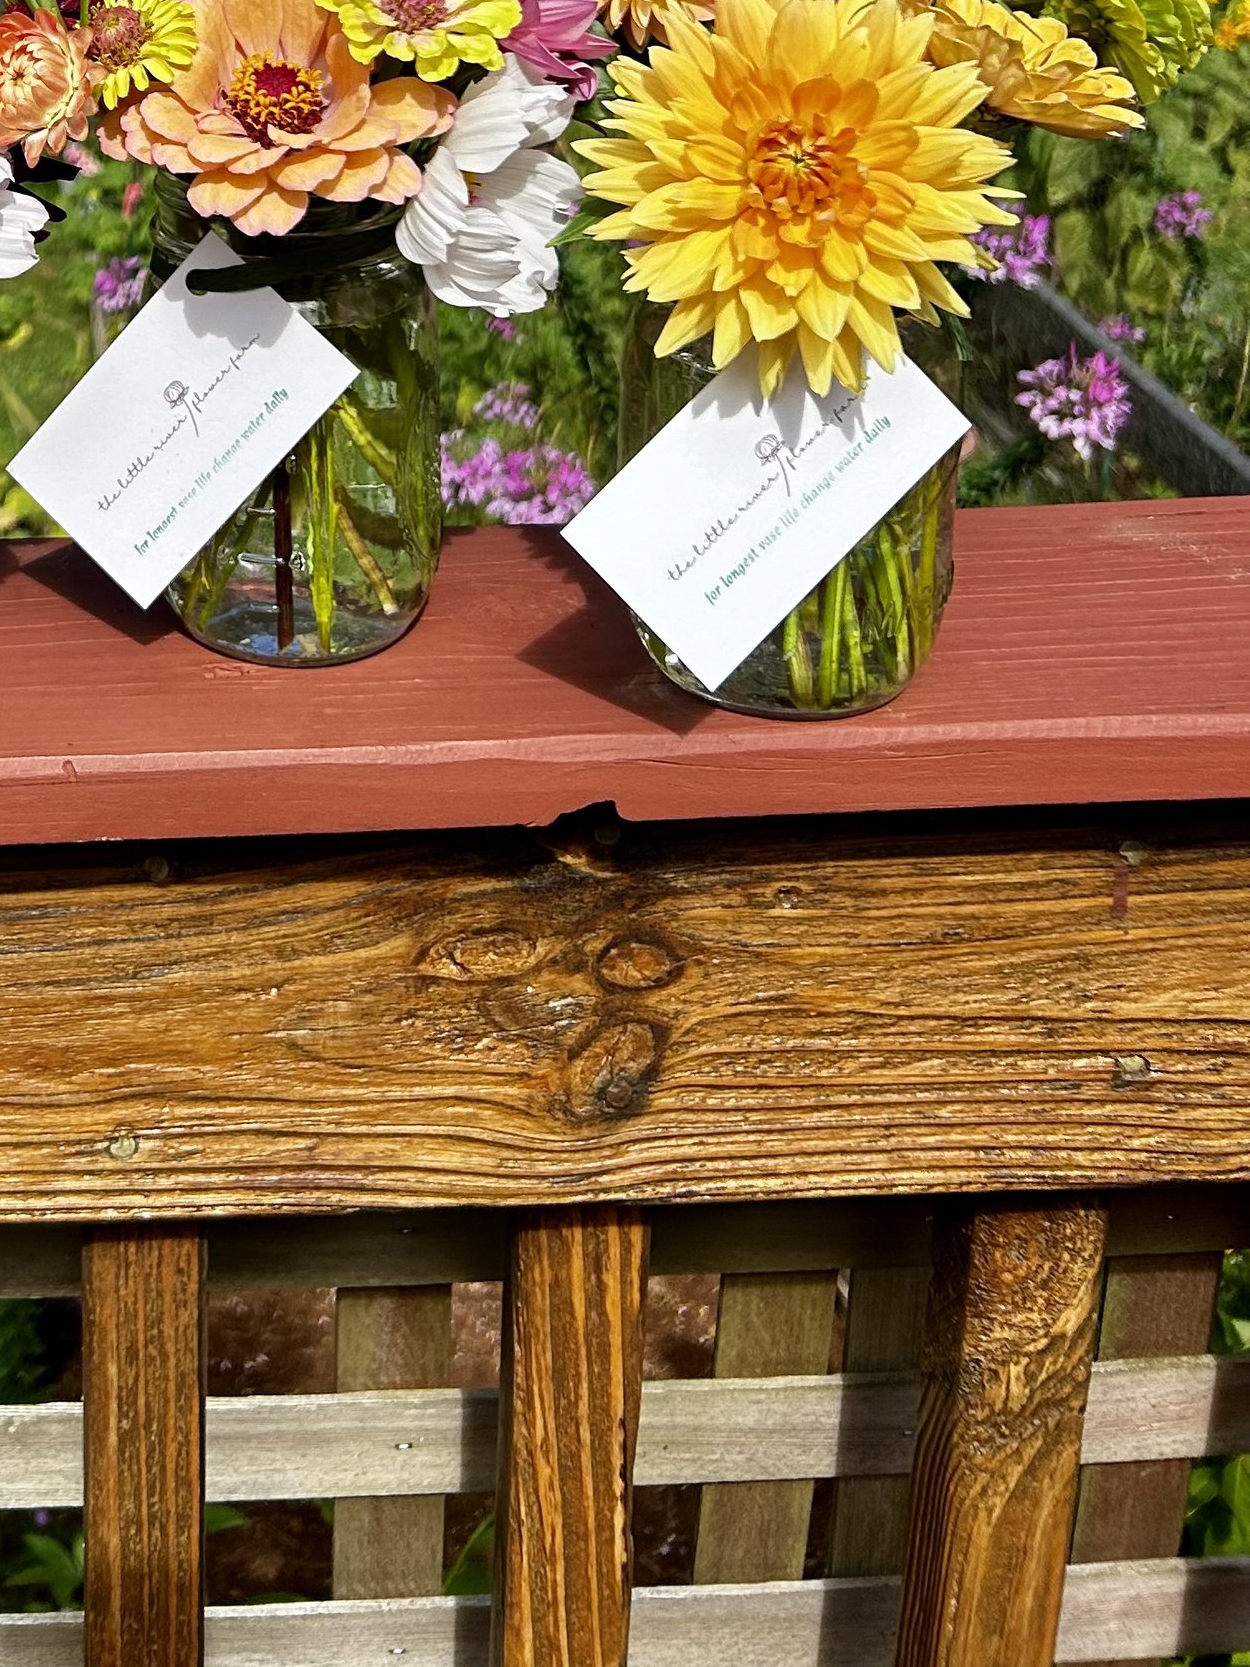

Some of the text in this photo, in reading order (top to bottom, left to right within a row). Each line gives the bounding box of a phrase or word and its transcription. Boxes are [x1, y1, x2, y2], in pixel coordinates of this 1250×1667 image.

[98, 489, 121, 510] the
[667, 556, 697, 581] the
[693, 513, 738, 556] little
[738, 471, 780, 512] river
[787, 418, 834, 470] flower
[705, 415, 892, 606] for longest vase life change water daily
